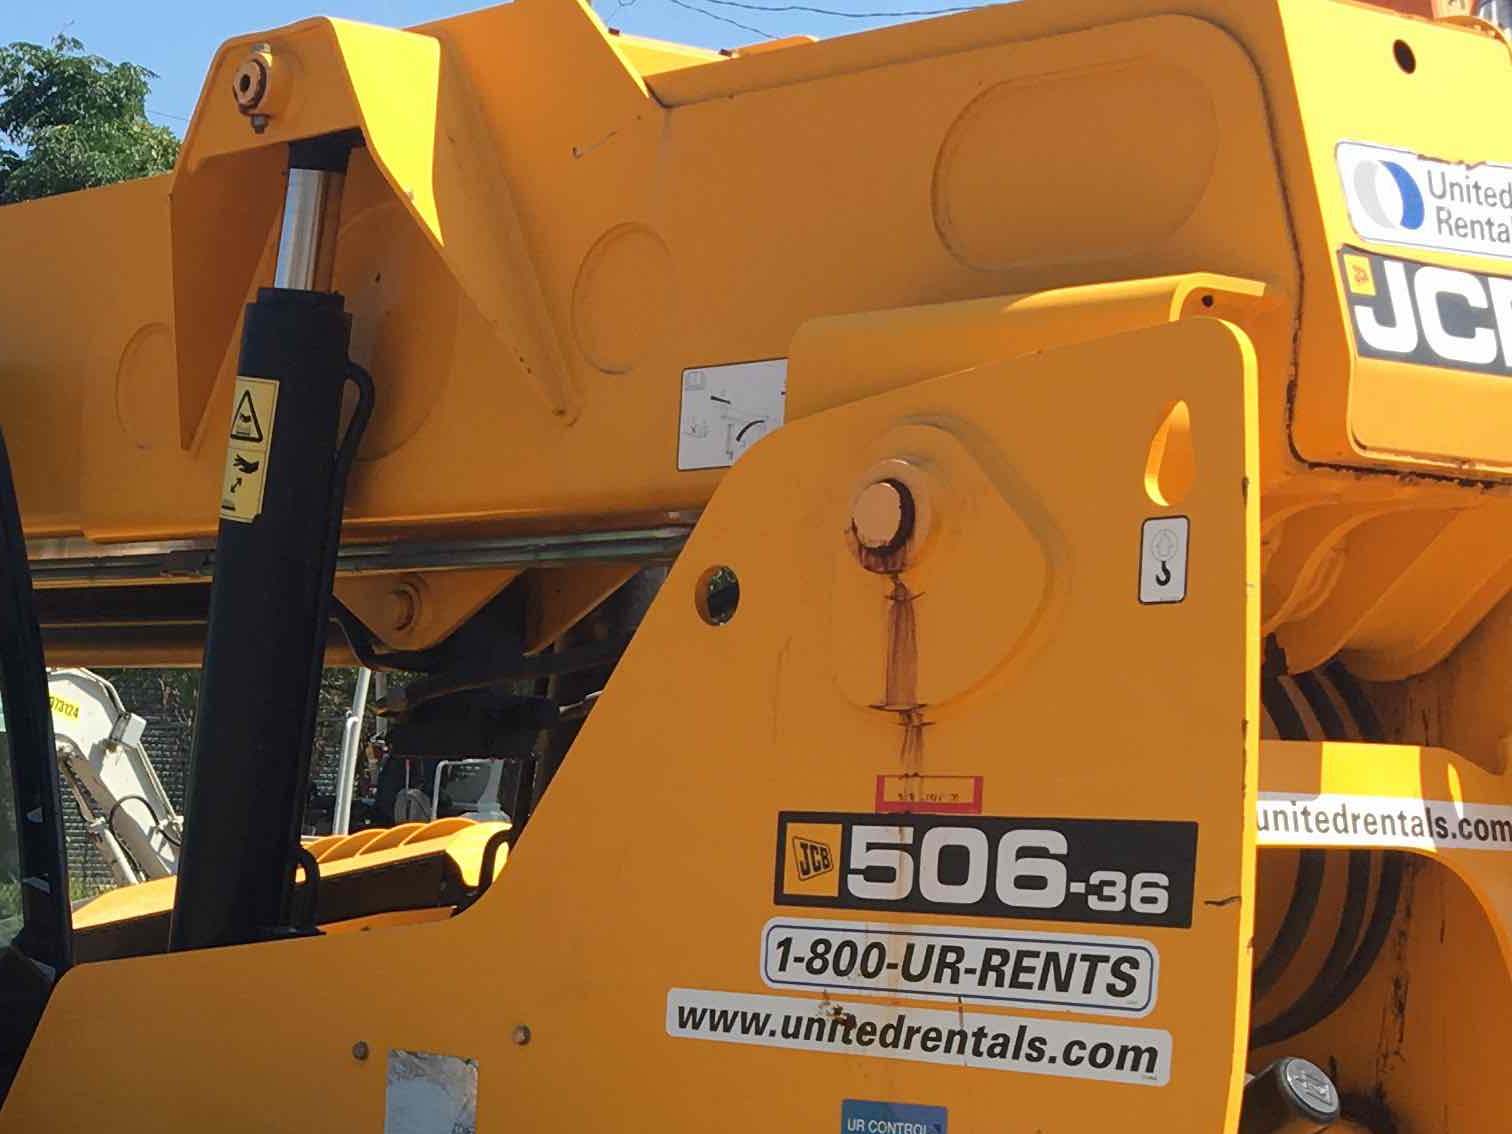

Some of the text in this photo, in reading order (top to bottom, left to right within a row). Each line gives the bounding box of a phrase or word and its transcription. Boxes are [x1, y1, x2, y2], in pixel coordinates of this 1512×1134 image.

[1426, 168, 1512, 210] United
[1435, 205, 1512, 244] Renta
[799, 841, 831, 877] JCB
[775, 936, 1141, 999] 1-800-UR-RENTS
[677, 1004, 1159, 1075] www.unitedrentals.com
[847, 1117, 865, 1132] UR
